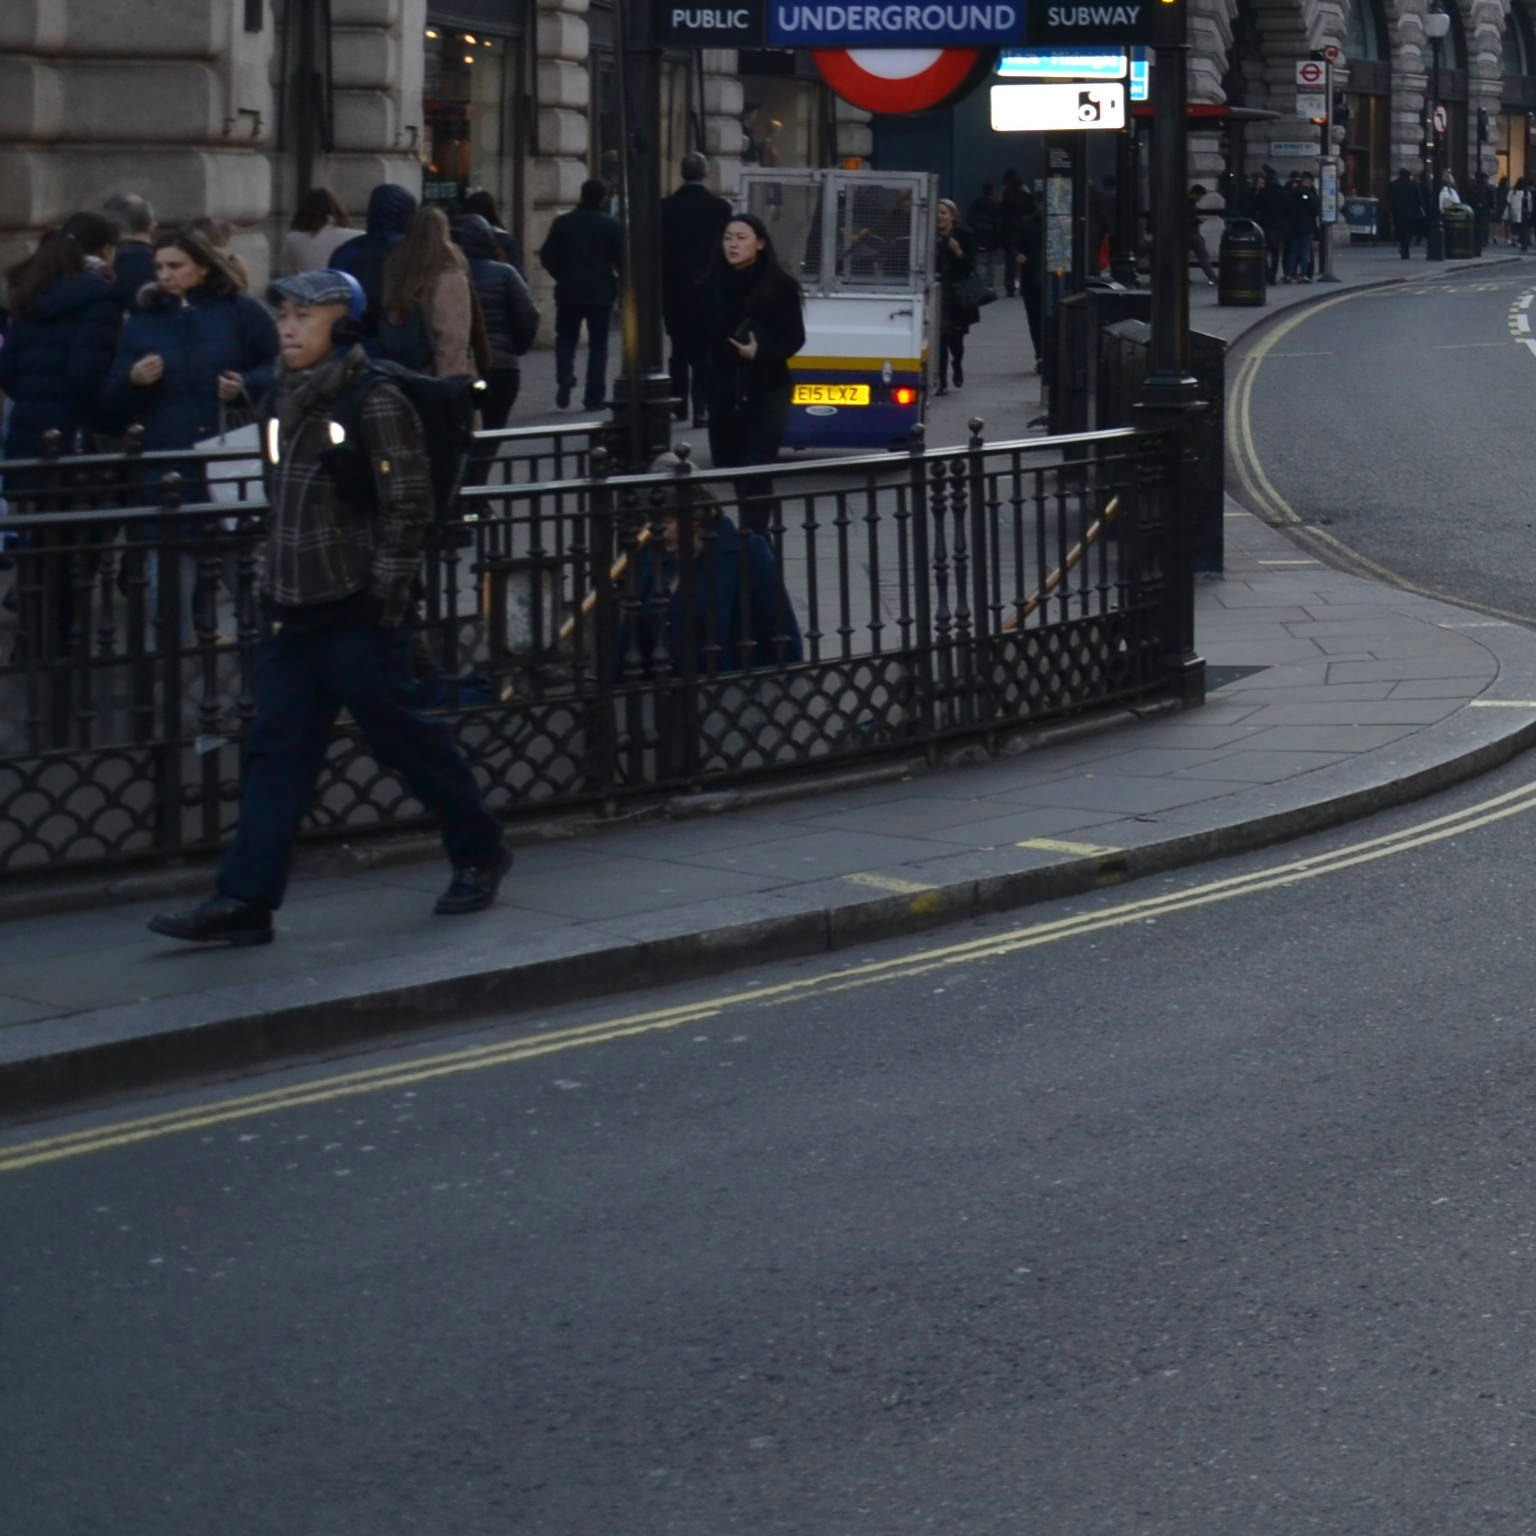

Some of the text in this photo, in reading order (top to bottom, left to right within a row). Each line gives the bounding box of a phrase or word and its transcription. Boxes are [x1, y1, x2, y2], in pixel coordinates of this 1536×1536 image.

[672, 5, 1141, 31] PUBLIC UNDERGROUND SUBWAY
[797, 386, 858, 402] E15 LXZ
